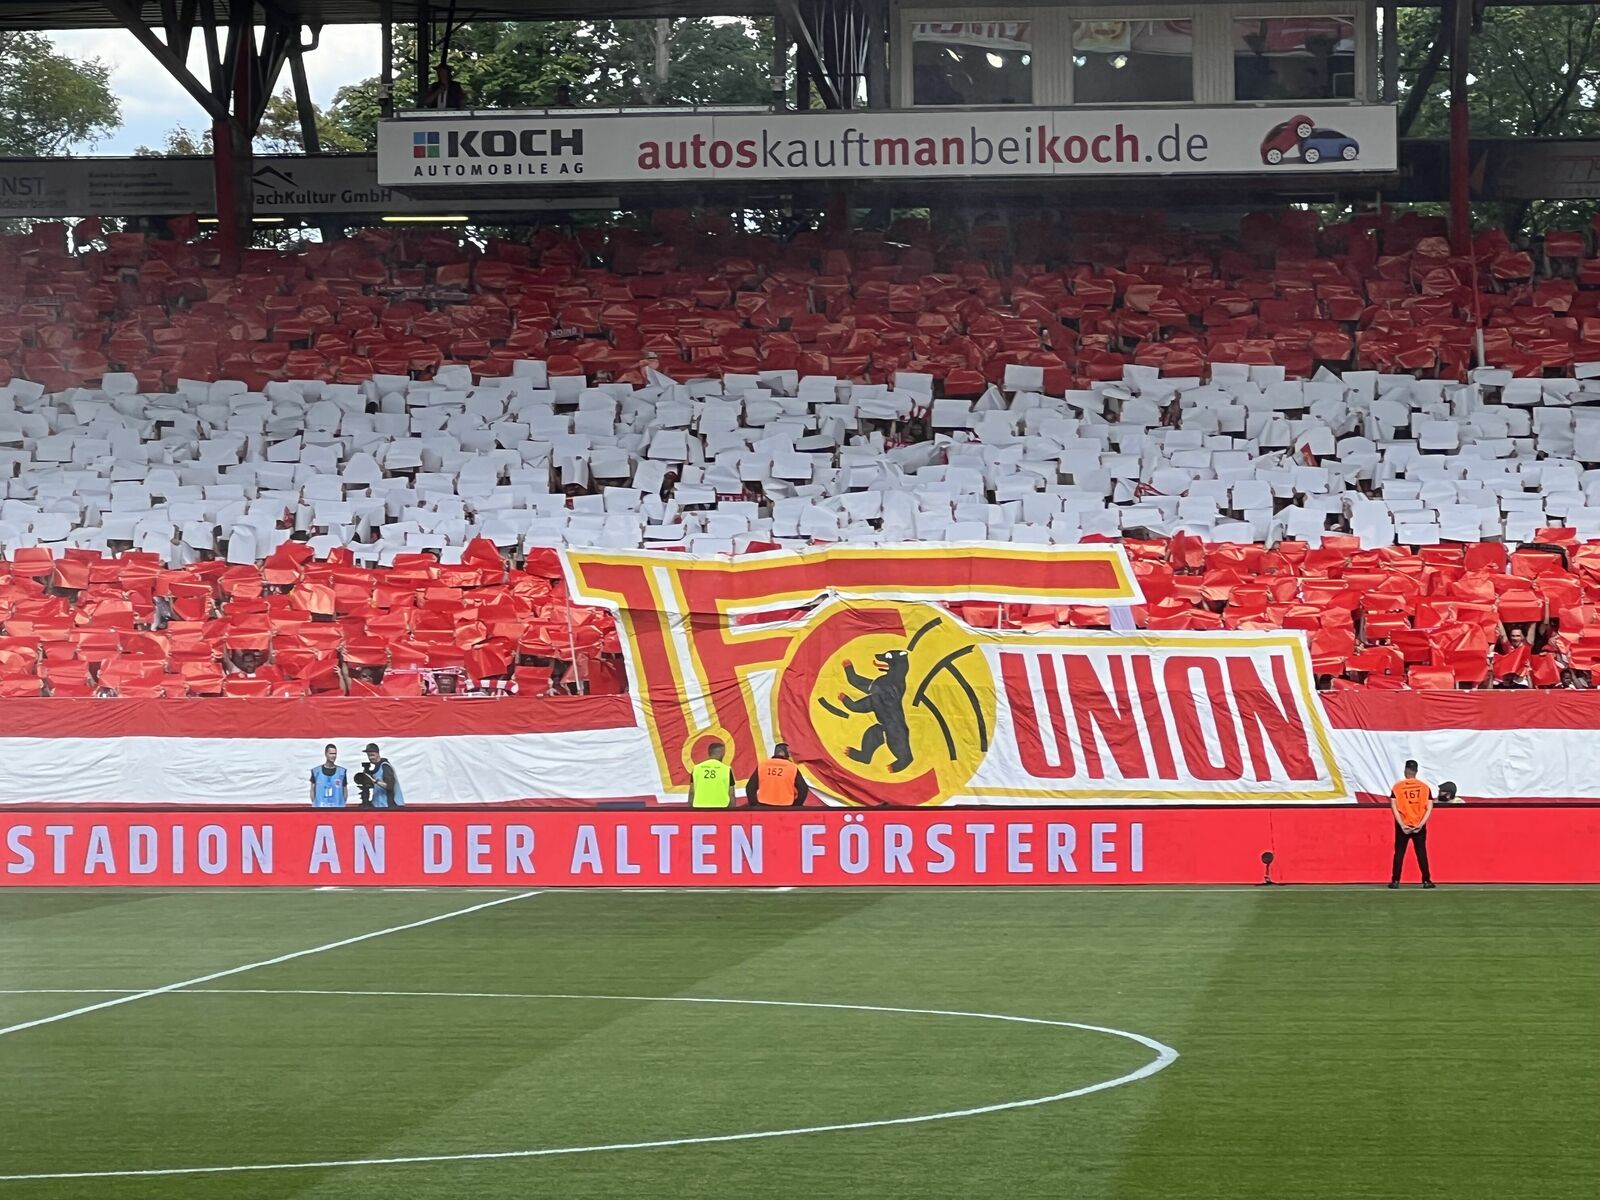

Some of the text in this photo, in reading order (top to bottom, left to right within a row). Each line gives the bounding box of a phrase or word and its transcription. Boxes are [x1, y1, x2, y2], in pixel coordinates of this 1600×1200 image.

[447, 129, 583, 158] KOCH
[638, 123, 1208, 169] autoskauftmanbeikoch.de
[414, 161, 584, 177] AUTOMOBILE AG
[253, 188, 392, 204] achKultur GmbH
[1000, 653, 1320, 782] UNION
[704, 770, 717, 779] 28
[767, 768, 783, 777] 162
[1404, 789, 1421, 799] 167
[7, 813, 1144, 875] STADION AN DER ALTEN FÖRSTEREI
